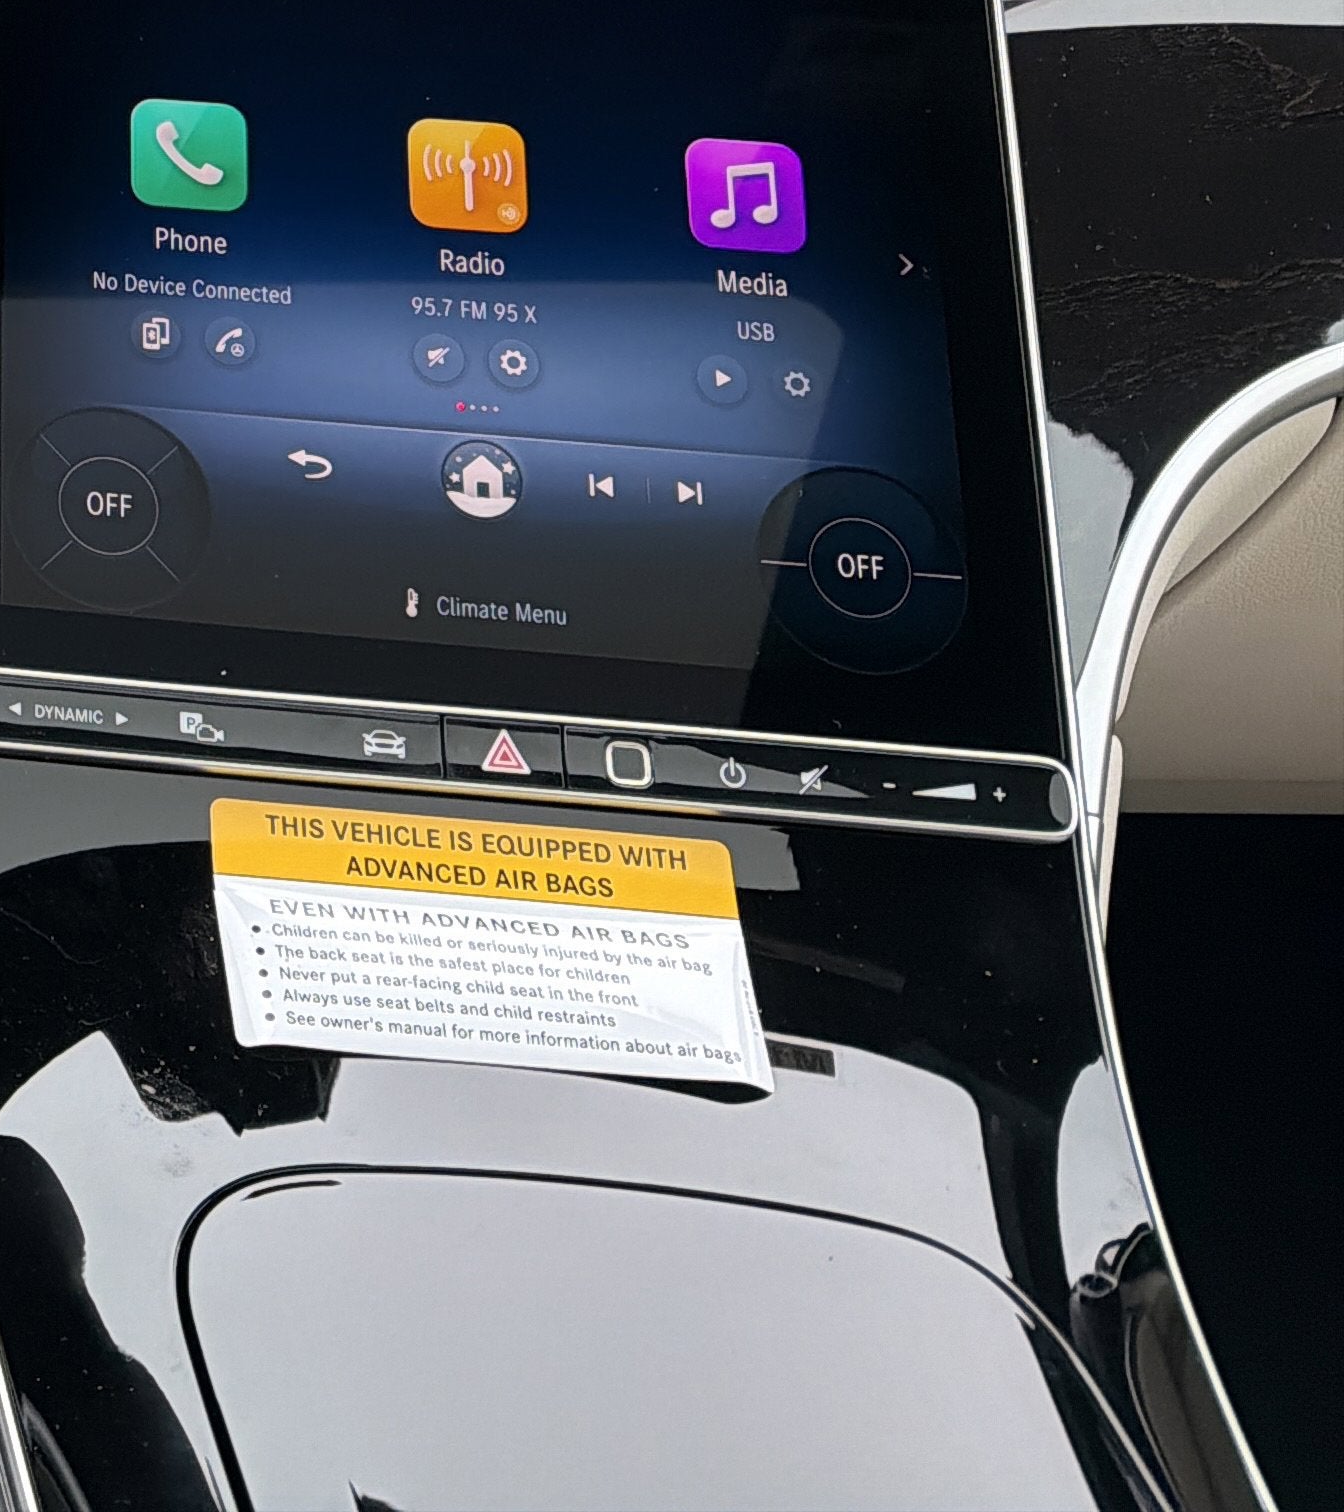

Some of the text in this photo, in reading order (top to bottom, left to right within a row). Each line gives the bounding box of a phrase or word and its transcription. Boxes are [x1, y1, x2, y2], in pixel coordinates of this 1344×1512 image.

[154, 226, 228, 255] Phone
[440, 248, 505, 276] Radio
[92, 270, 292, 306] No Device Connected
[717, 269, 789, 298] Media
[411, 296, 538, 325] 95.7 FM 95 X
[737, 320, 775, 343] USB
[85, 489, 133, 520] OFF
[836, 551, 885, 583] OFF
[437, 595, 567, 626] Climate Menu
[34, 703, 104, 725] DYNAMIC
[265, 814, 687, 871] THIS VEHICLE IS EQUIPPED WITH
[346, 856, 614, 898] ADVANCED AIR BAGS
[269, 899, 690, 949] EVEN WITH ADVANCED AIR BAGS
[272, 923, 713, 976] Children can be killed or seriously injured by the air bag
[275, 944, 631, 985] The back seat is the safest place for children
[279, 966, 639, 1007] Never put a rear-facing child seat in the front
[283, 989, 617, 1028] Always use seat belts and child restraints
[285, 1010, 742, 1065] See owner's manual for more information about air bags
